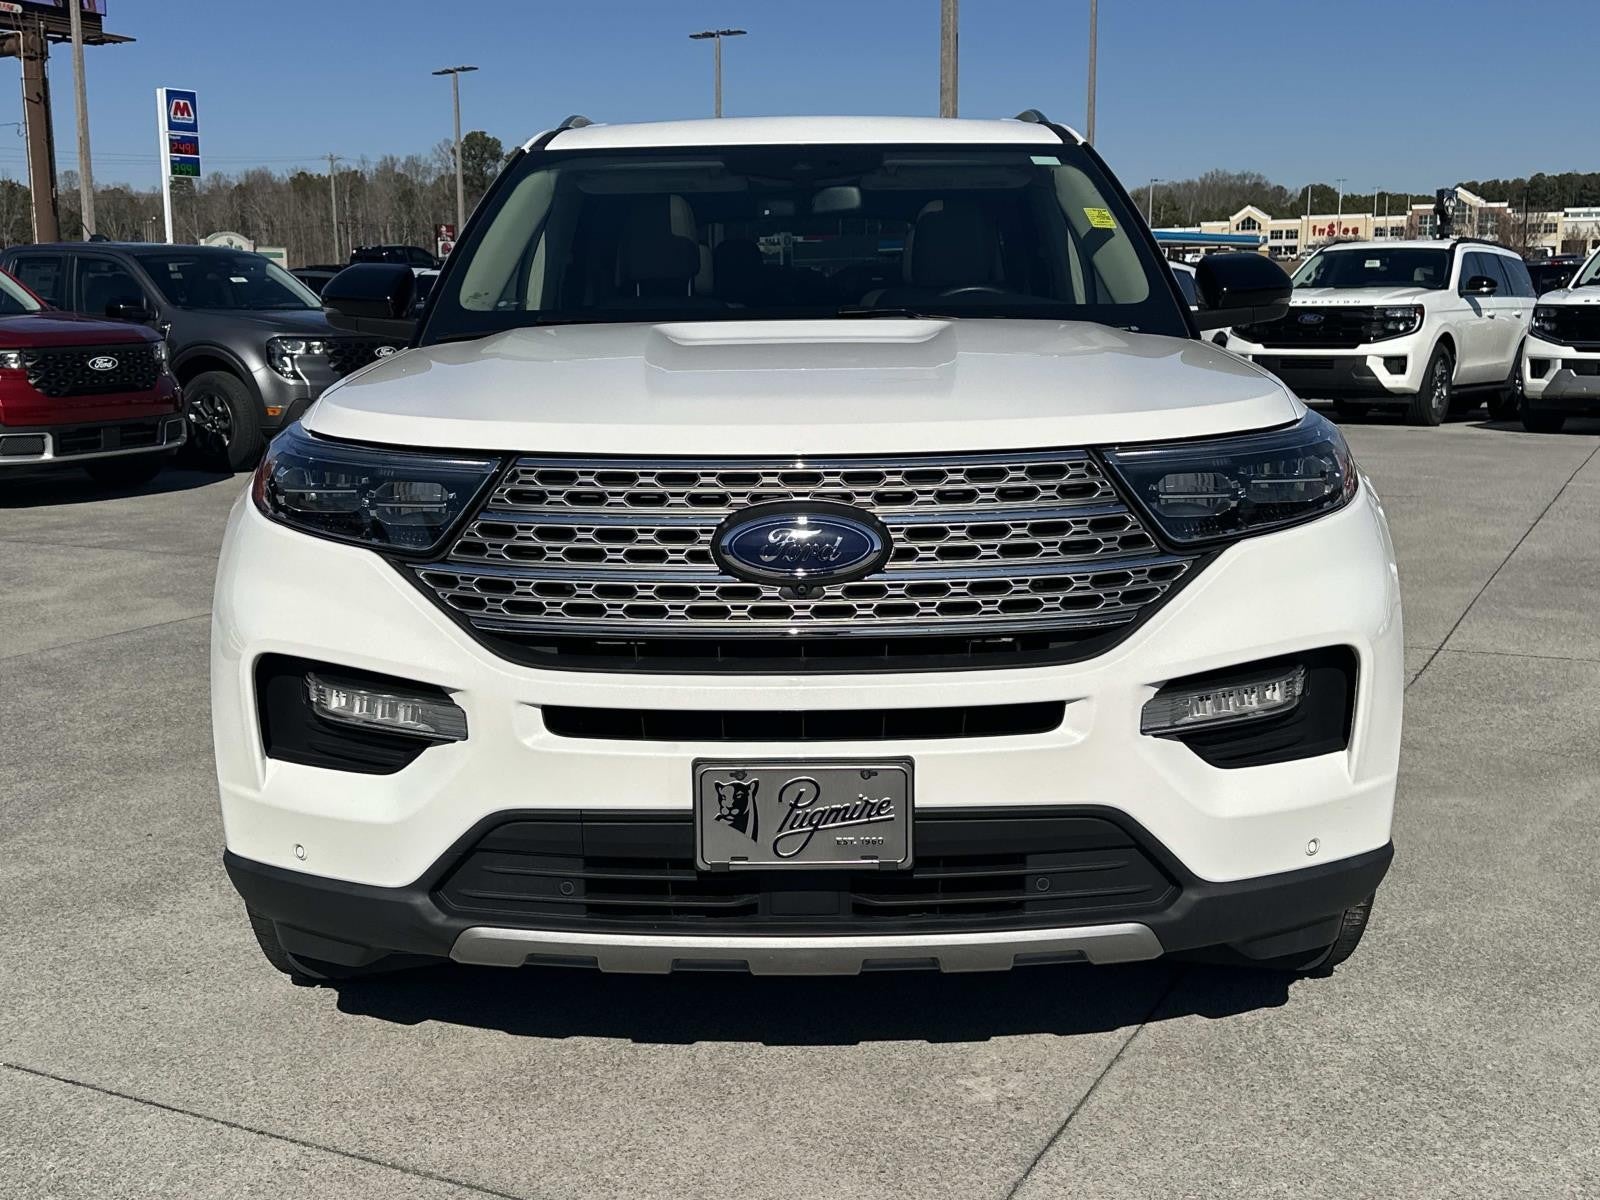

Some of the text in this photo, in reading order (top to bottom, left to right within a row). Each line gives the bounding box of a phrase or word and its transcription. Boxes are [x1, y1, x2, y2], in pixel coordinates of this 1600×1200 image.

[94, 358, 113, 369] Ford
[759, 527, 843, 562] Ford
[772, 776, 895, 858] Pugmire
